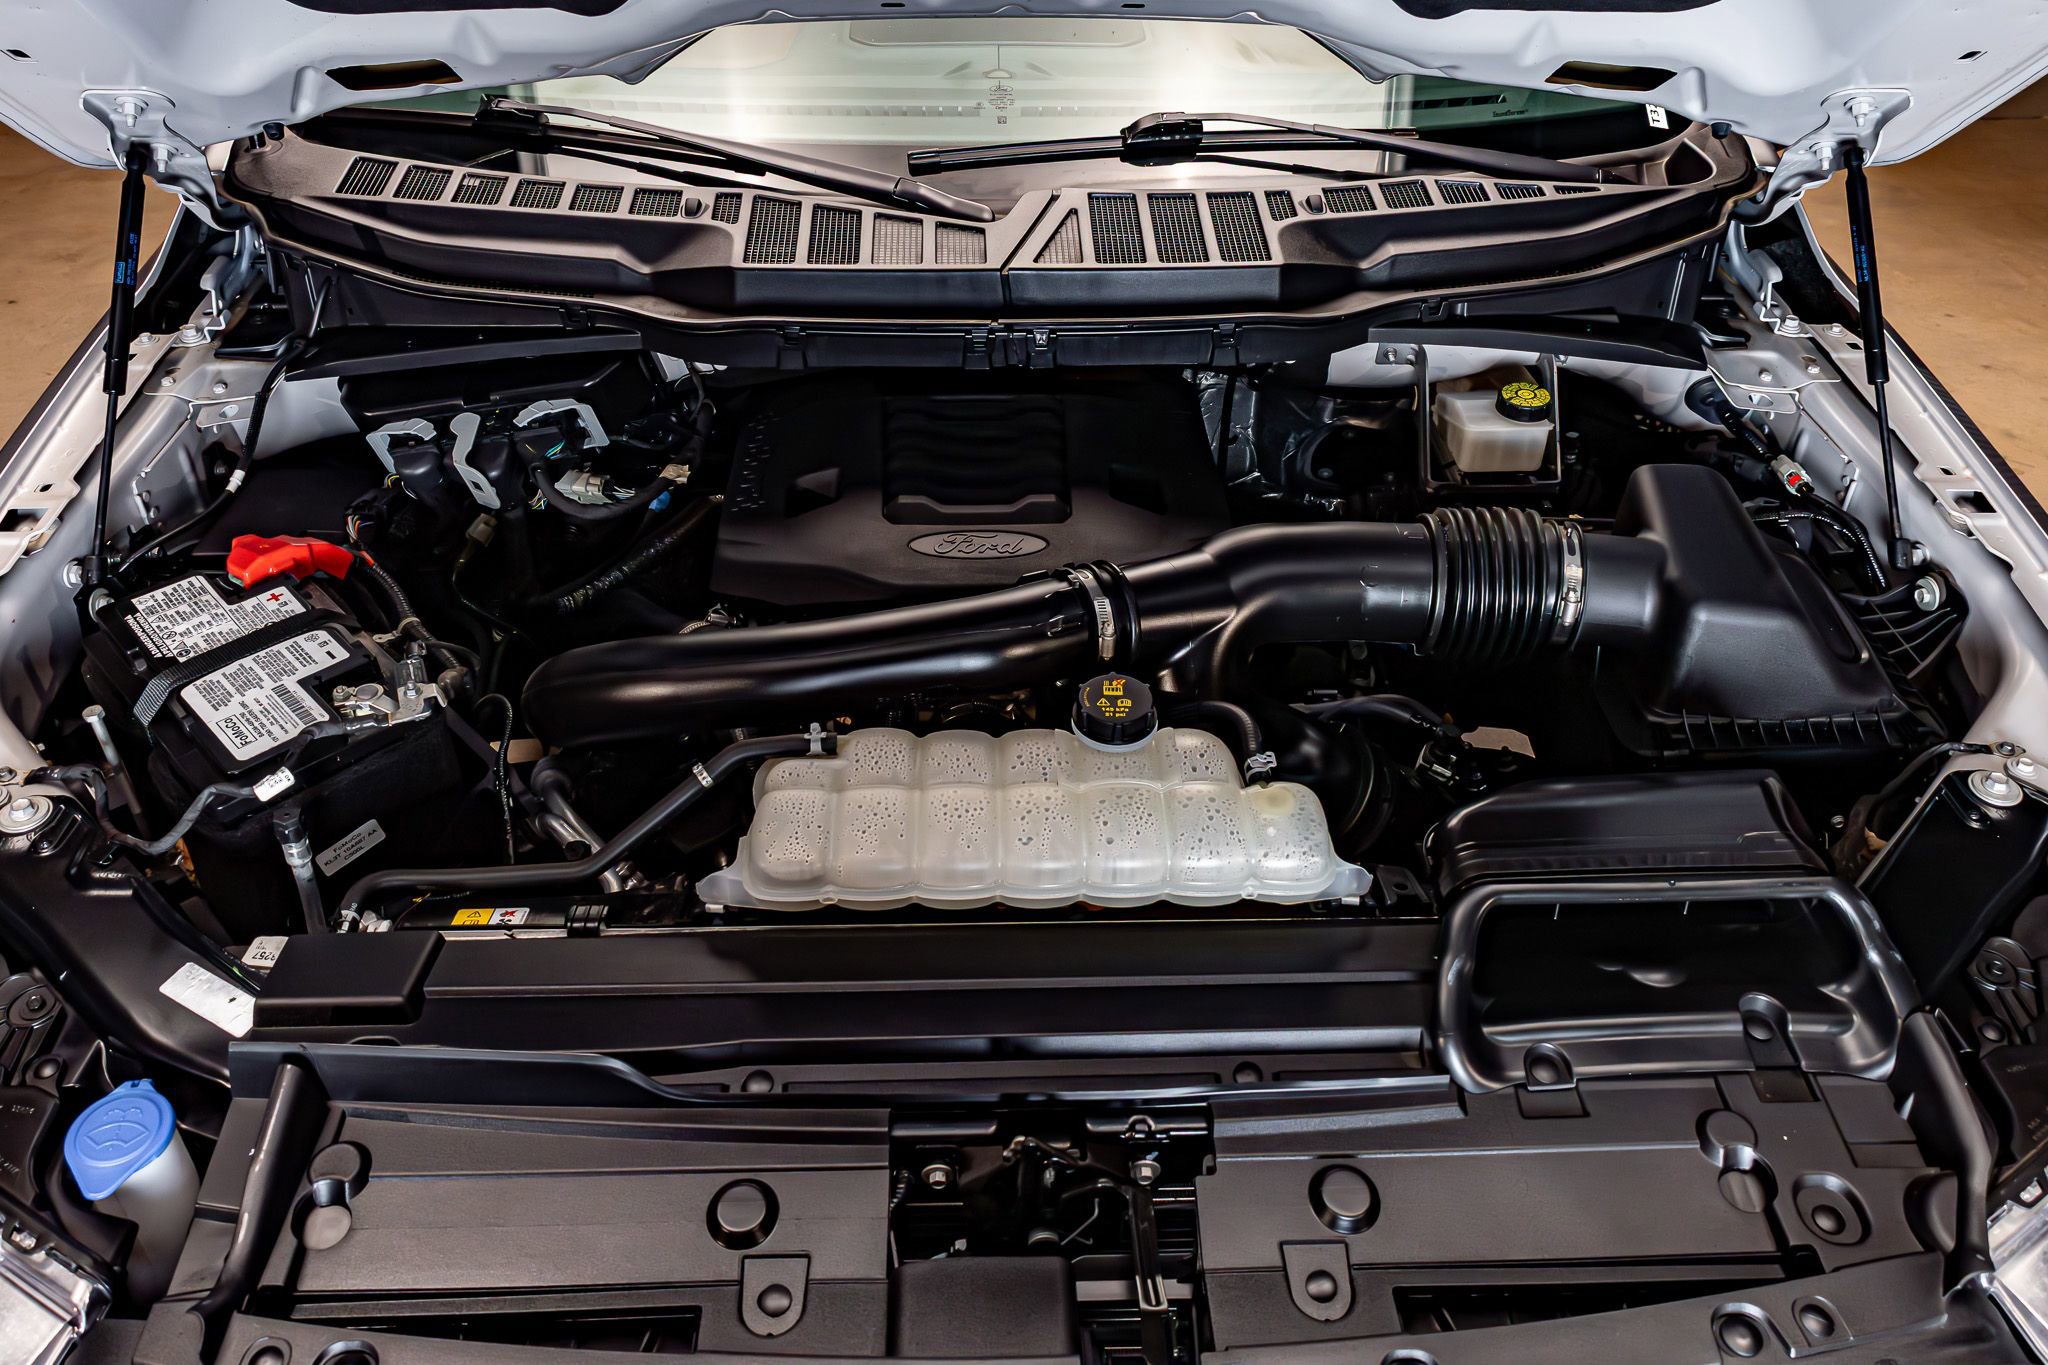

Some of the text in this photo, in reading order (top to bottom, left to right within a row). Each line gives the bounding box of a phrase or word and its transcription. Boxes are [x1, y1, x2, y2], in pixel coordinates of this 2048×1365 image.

[934, 533, 1024, 554] Ford
[224, 717, 253, 747] FoMoCo
[333, 832, 361, 853] FoMoCo
